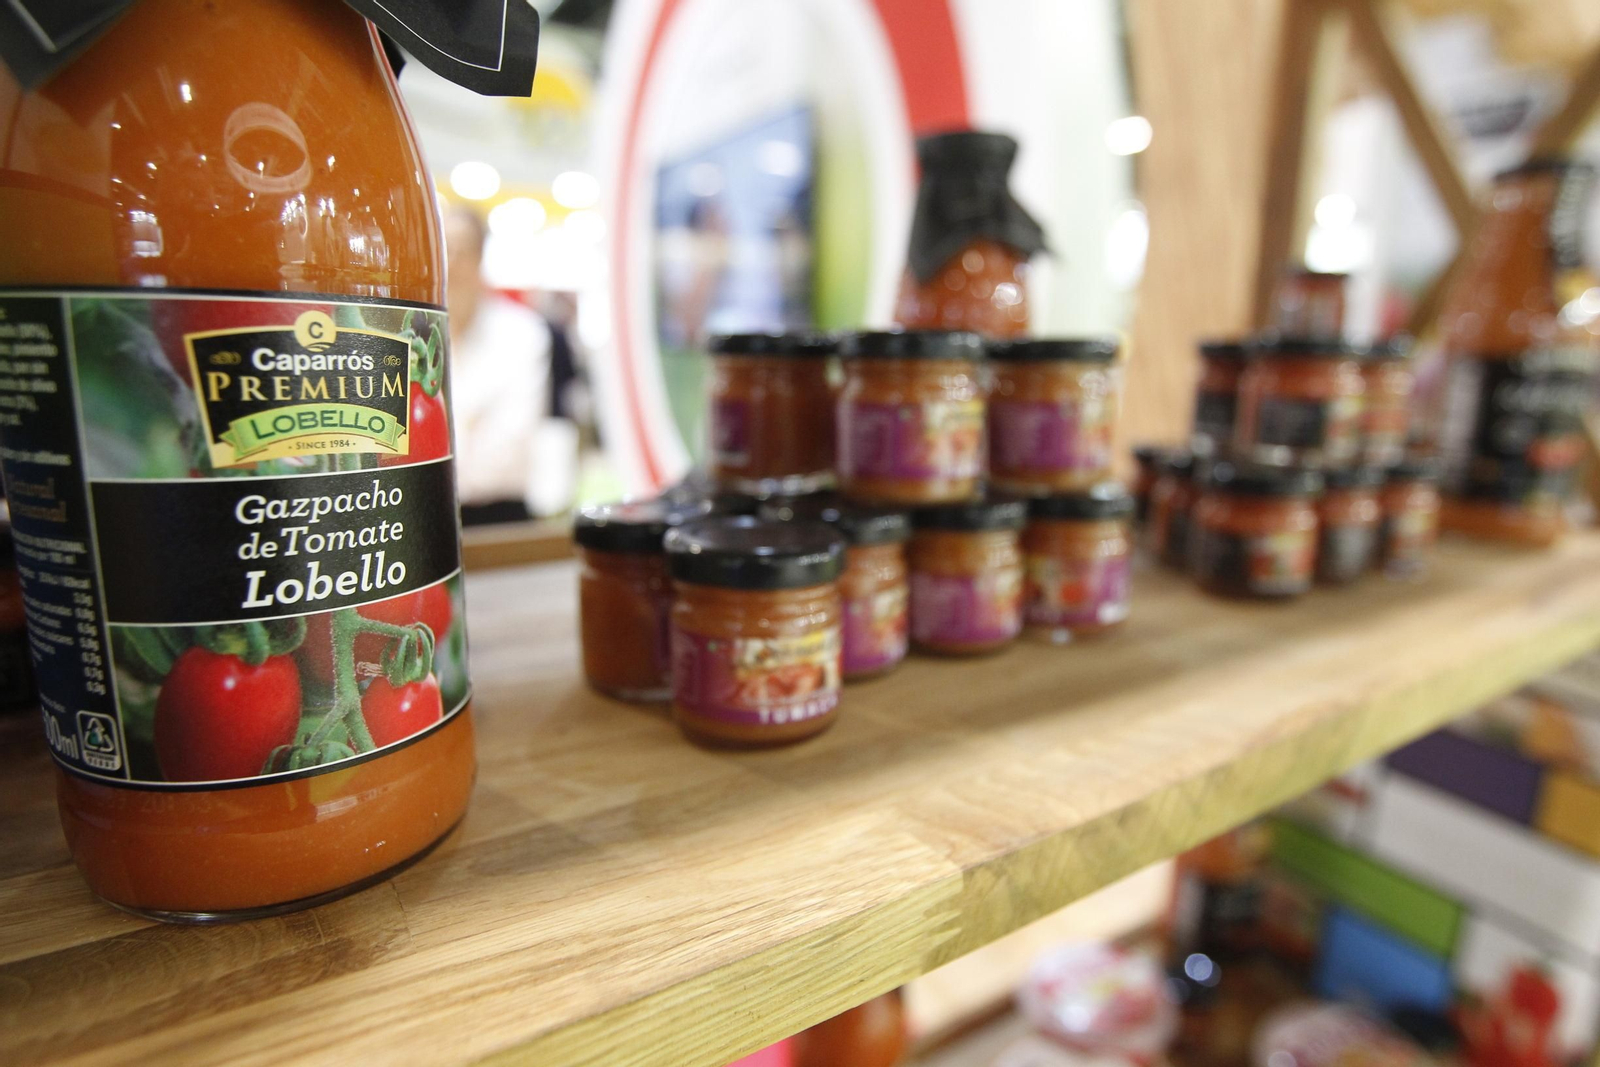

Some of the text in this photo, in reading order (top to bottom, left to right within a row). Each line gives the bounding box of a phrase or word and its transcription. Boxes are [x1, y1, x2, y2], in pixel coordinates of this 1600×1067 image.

[308, 321, 324, 339] C
[252, 347, 374, 375] Caparrós
[205, 371, 405, 402] PREMIUM
[250, 409, 386, 439] LOBELLO
[295, 439, 350, 450] SINCE 1984
[235, 479, 403, 525] Gazpacho
[238, 519, 404, 560] de Tomate
[241, 550, 407, 609] Lobello
